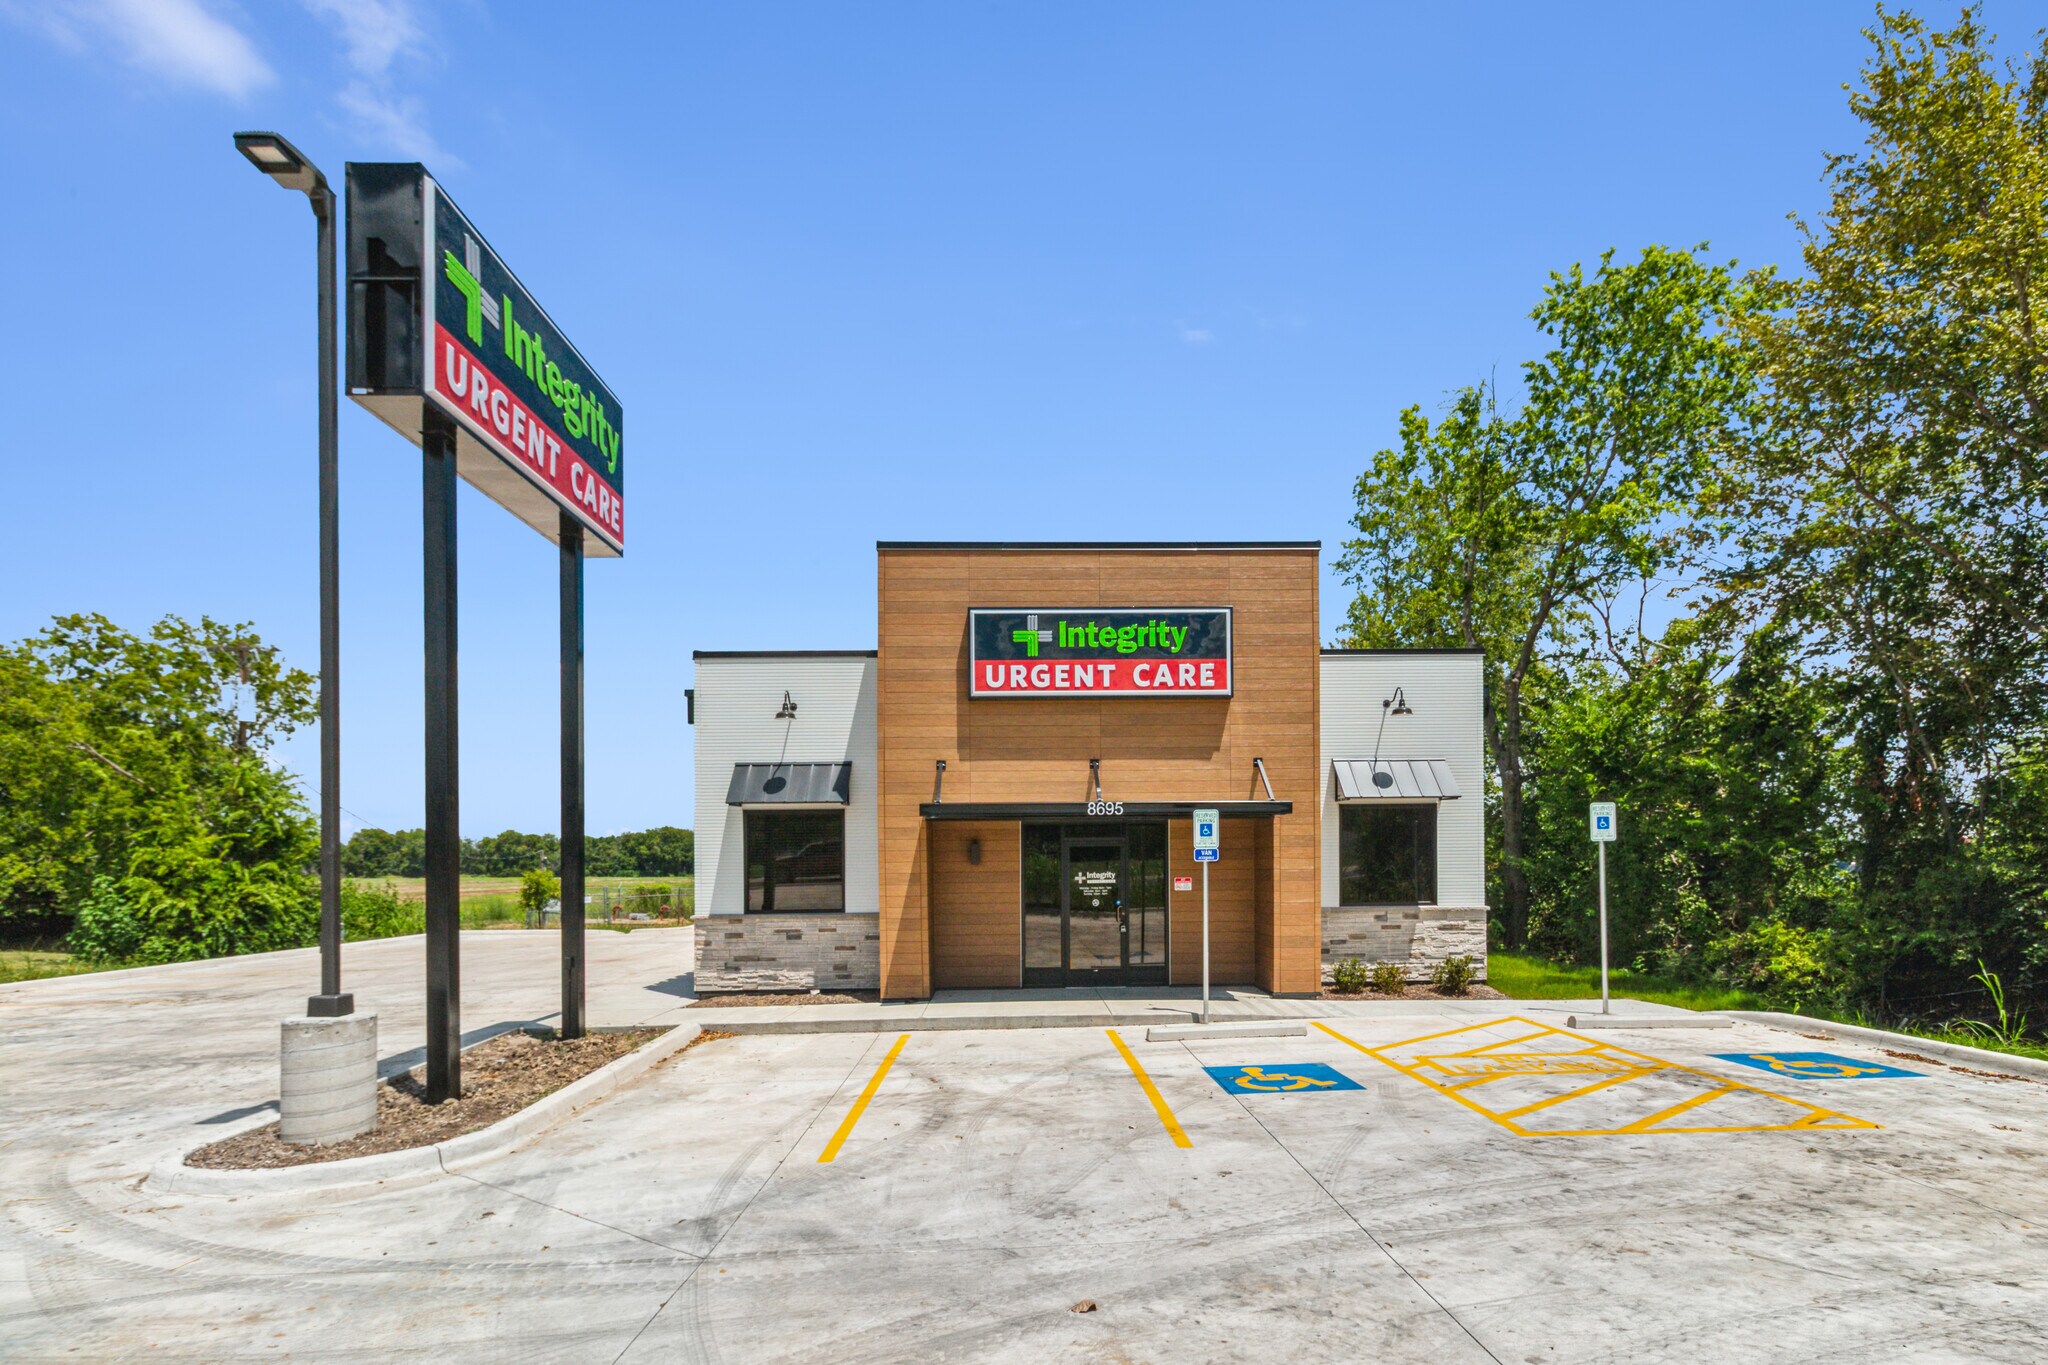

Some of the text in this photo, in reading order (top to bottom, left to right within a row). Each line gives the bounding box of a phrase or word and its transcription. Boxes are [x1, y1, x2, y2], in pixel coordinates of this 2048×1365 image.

[503, 293, 619, 474] Integrity
[446, 342, 621, 533] URGENT CARE
[1058, 619, 1188, 654] Integrity
[985, 663, 1215, 688] URGENT CARE
[1087, 801, 1124, 816] 8695
[1087, 871, 1116, 880] Integrity
